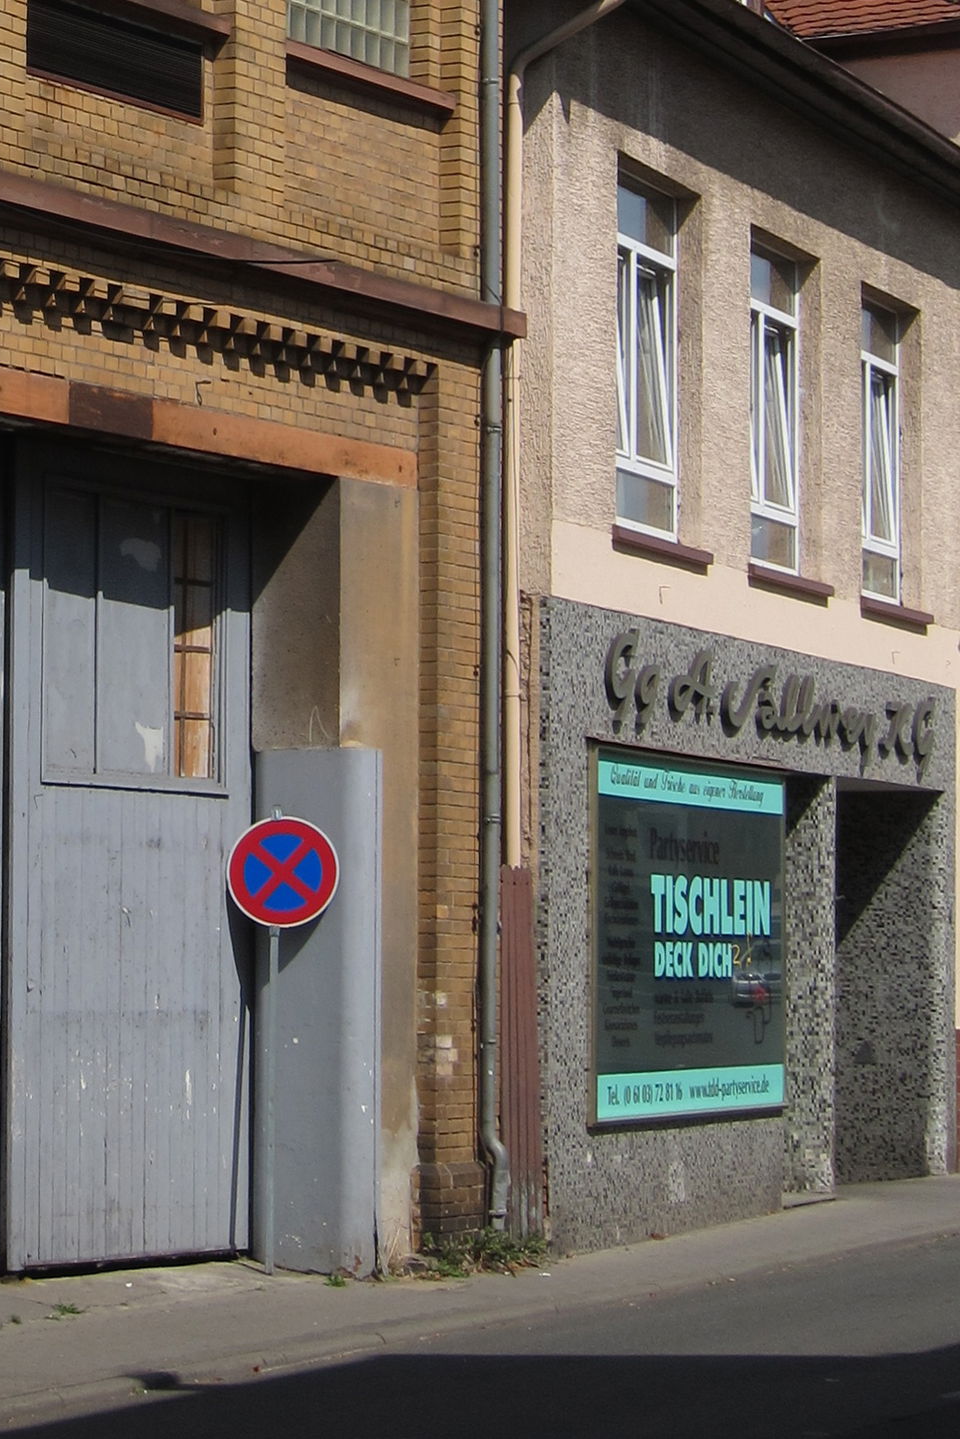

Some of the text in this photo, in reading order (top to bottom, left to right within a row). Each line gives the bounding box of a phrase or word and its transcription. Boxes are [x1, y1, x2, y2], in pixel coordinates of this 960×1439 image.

[643, 773, 659, 789] und
[649, 826, 720, 869] Partyservice
[650, 873, 772, 937] TISCHLEIN
[653, 941, 733, 978] DECK DICH
[607, 1083, 620, 1106] Tel.
